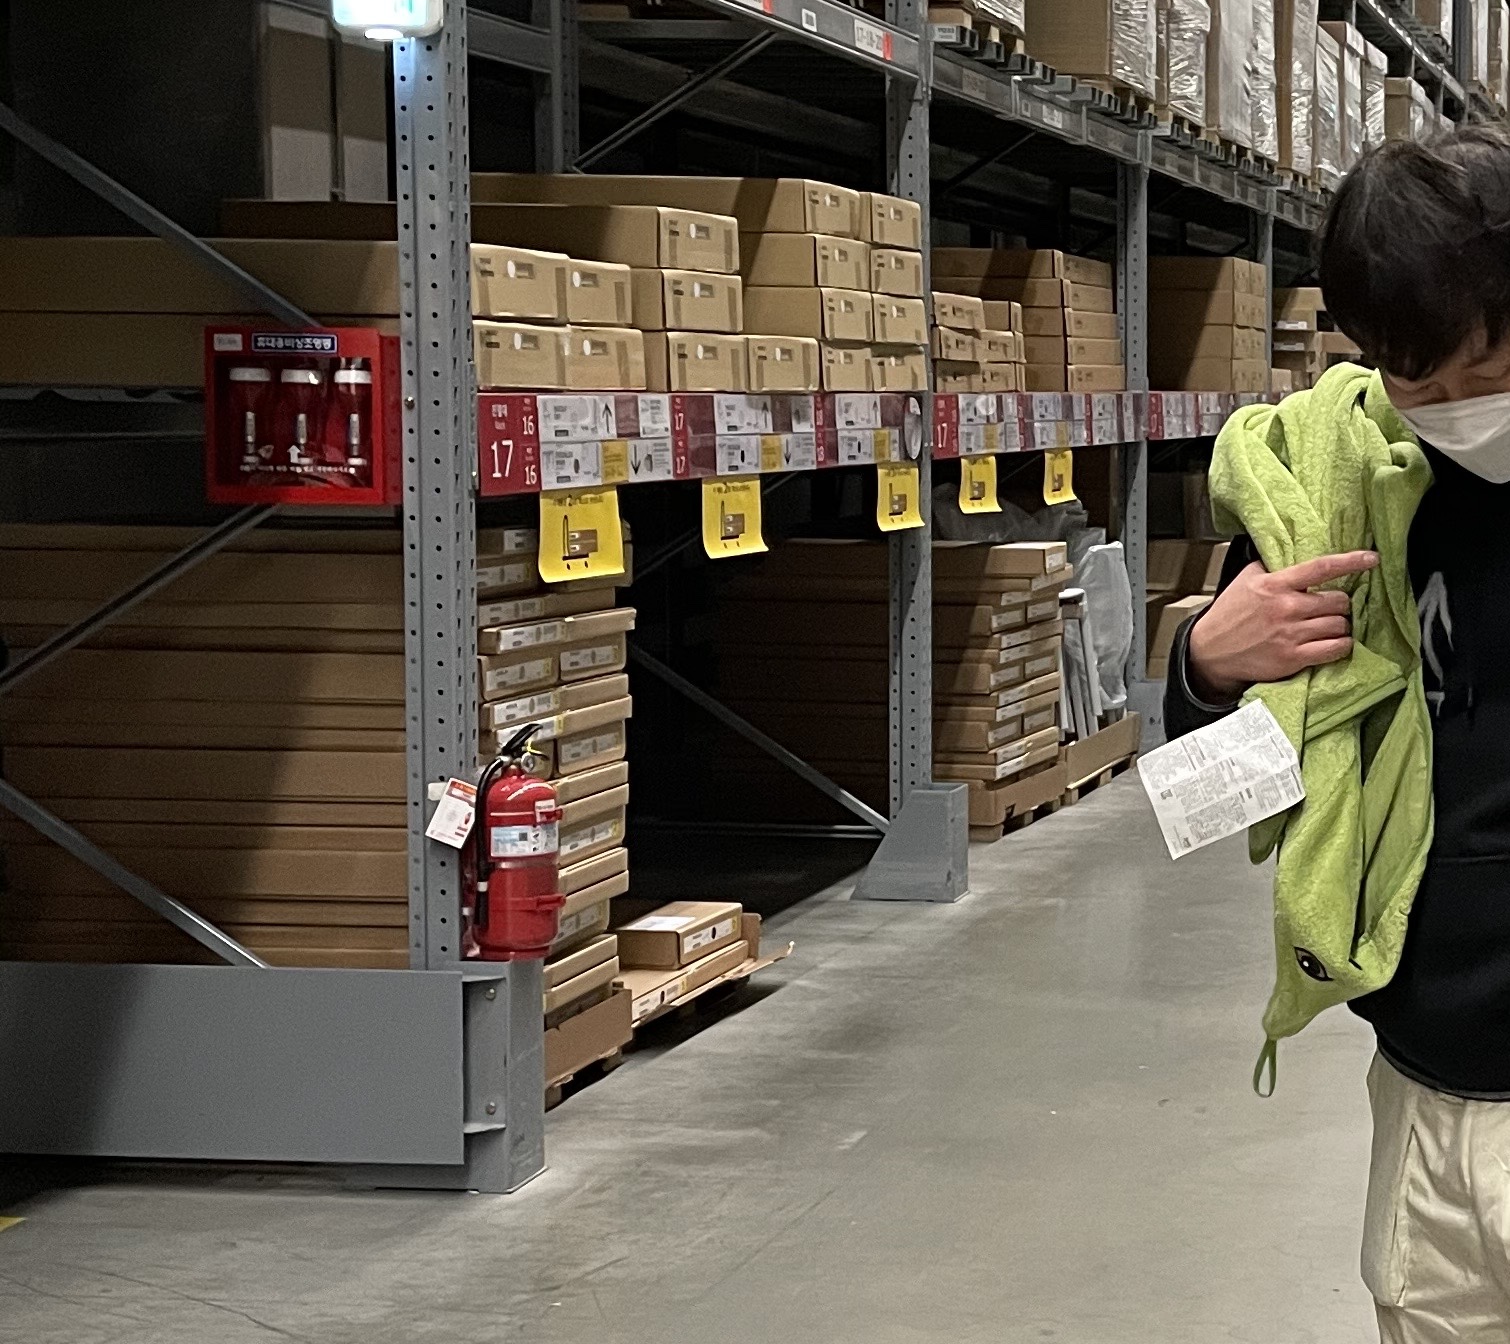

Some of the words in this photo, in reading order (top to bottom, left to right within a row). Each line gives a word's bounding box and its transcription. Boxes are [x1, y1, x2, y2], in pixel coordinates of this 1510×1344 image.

[522, 414, 535, 435] 16
[490, 439, 514, 478] 17
[524, 464, 537, 485] 16
